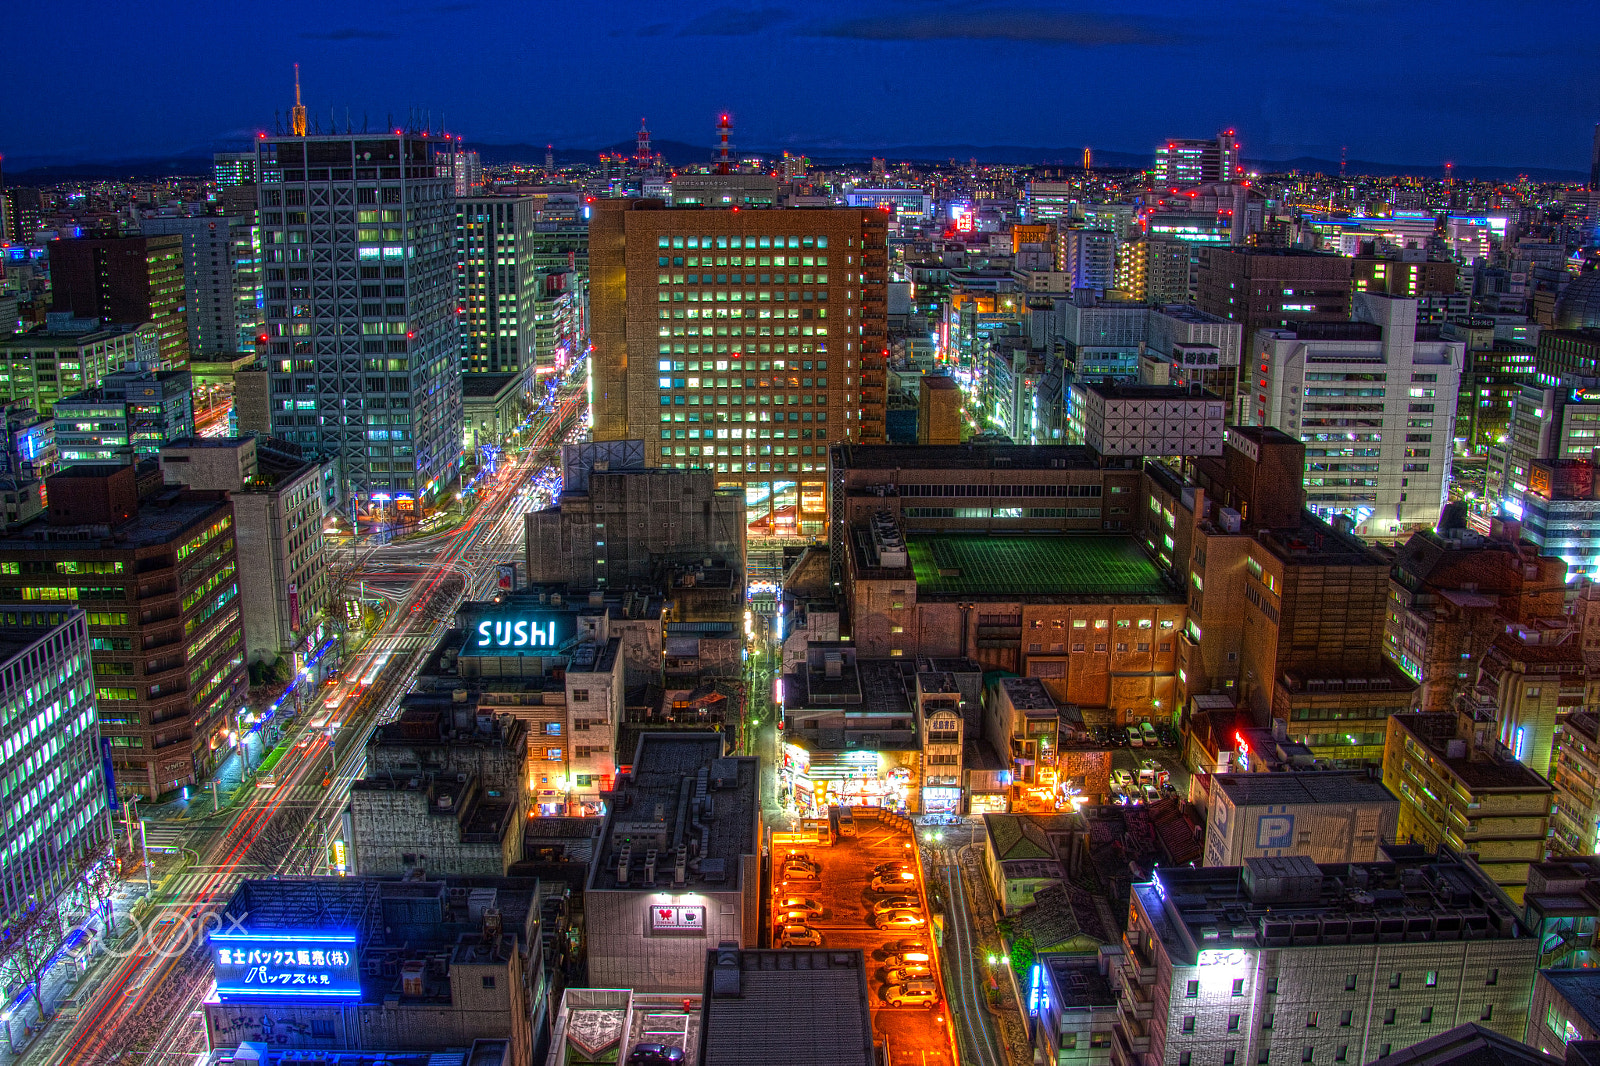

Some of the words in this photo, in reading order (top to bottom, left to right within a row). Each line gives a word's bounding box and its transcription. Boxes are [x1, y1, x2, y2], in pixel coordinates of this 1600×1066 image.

[478, 620, 556, 647] SUSHI
[218, 948, 350, 967] 富士パックス販売(株)
